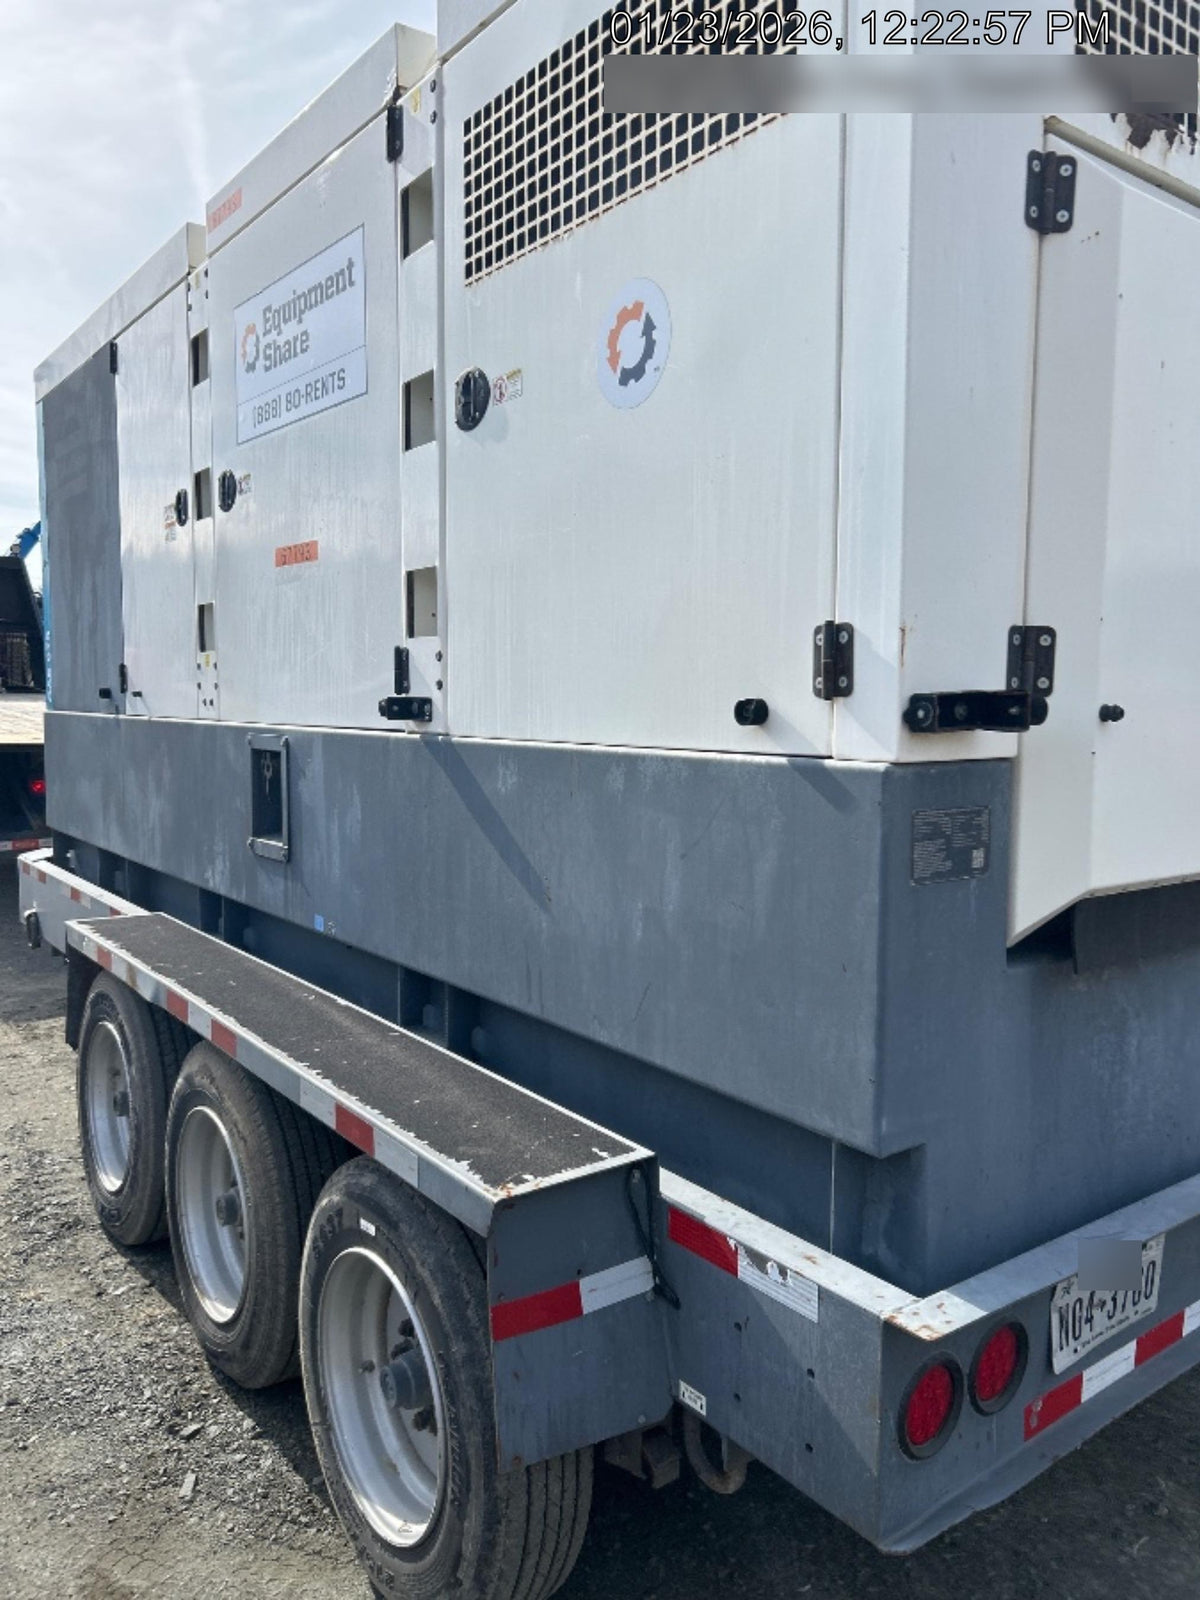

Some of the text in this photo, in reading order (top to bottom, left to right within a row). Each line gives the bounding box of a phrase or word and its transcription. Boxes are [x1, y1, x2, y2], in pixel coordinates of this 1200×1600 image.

[262, 257, 355, 338] Equipment
[262, 329, 310, 373] Share
[252, 368, 346, 428] (888) 80-RENTS
